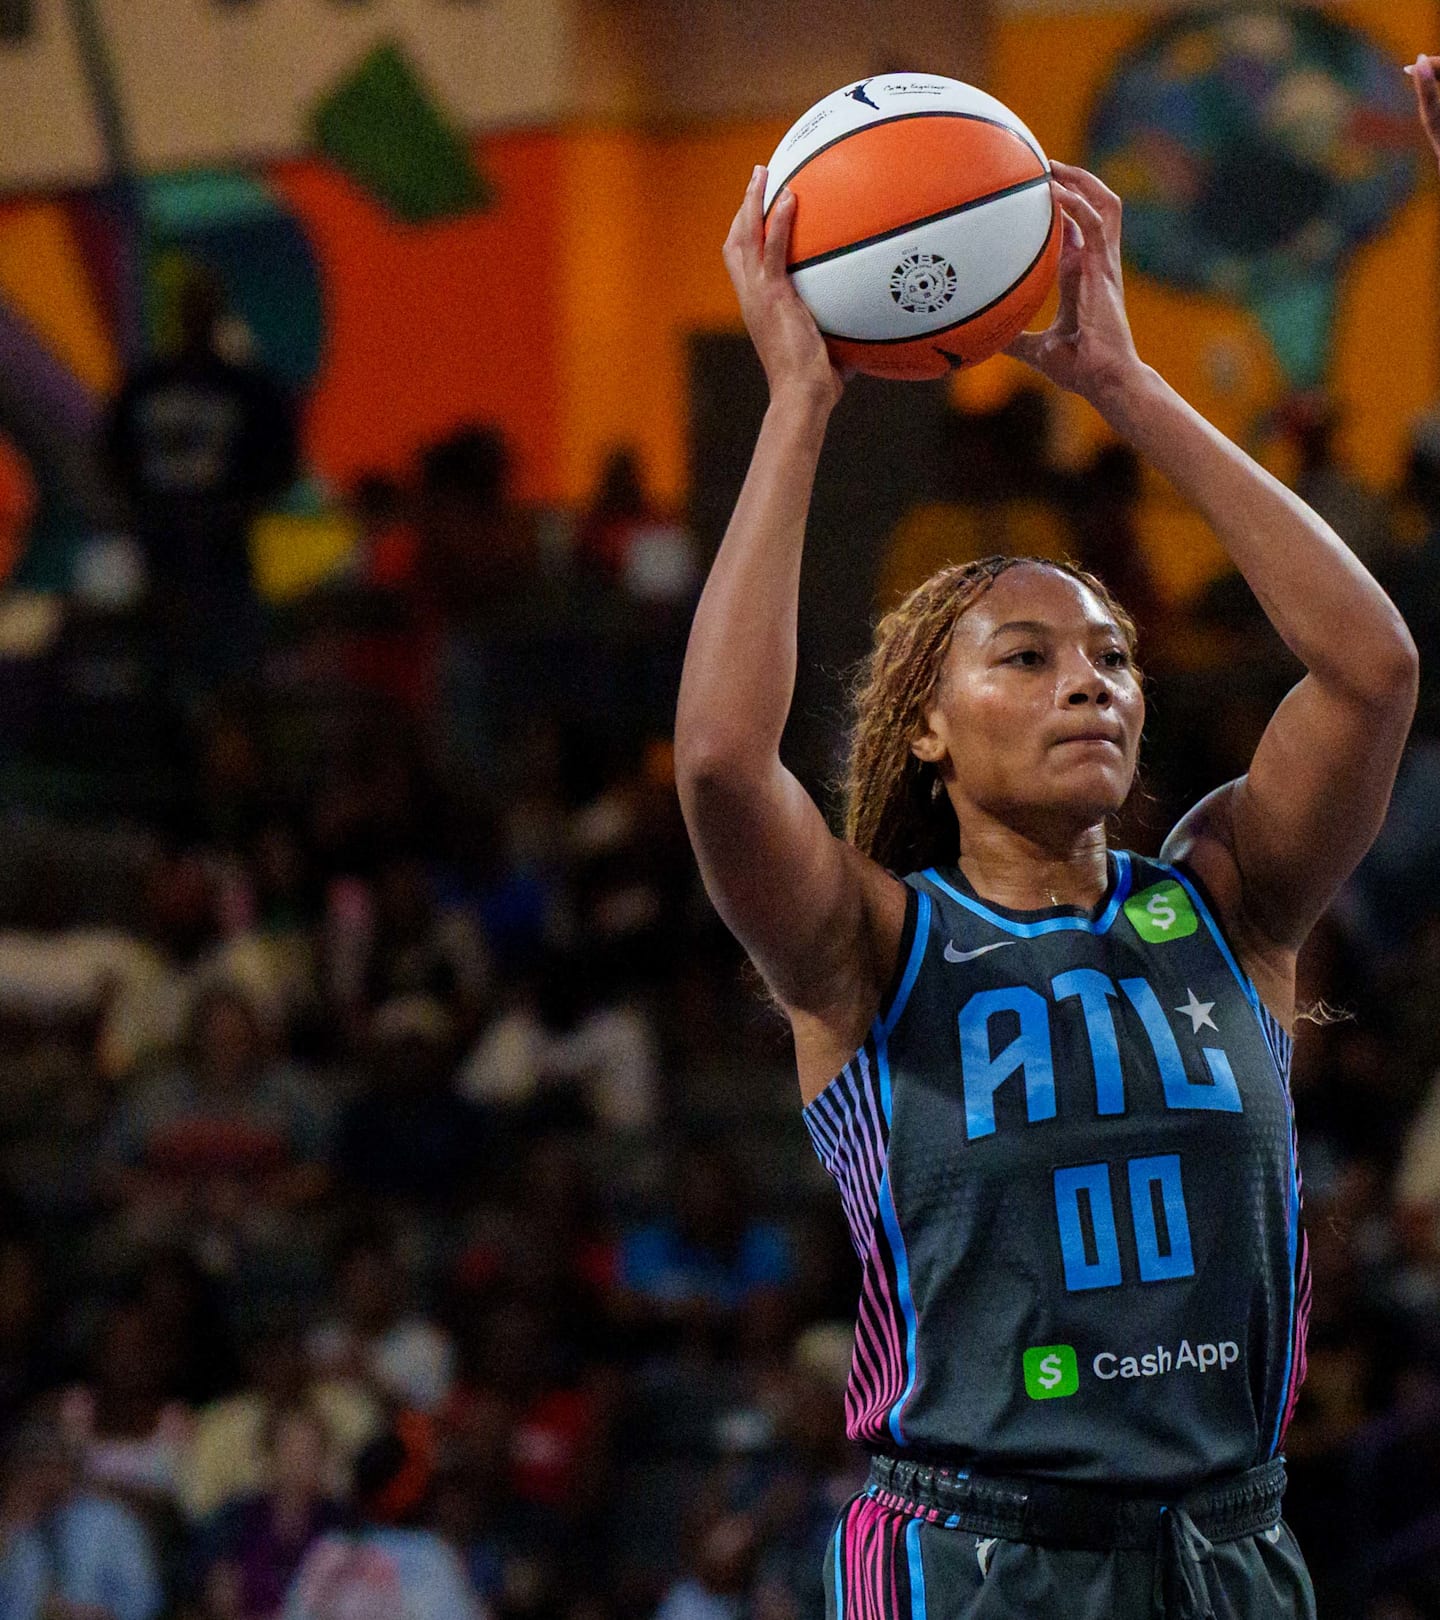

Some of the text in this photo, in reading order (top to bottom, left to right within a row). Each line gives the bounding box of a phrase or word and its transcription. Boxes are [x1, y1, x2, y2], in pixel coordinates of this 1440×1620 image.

[957, 968, 1243, 1140] ATL
[1054, 1154, 1195, 1291] 00
[1093, 1345, 1172, 1380] Cash
[1175, 1339, 1240, 1373] App
